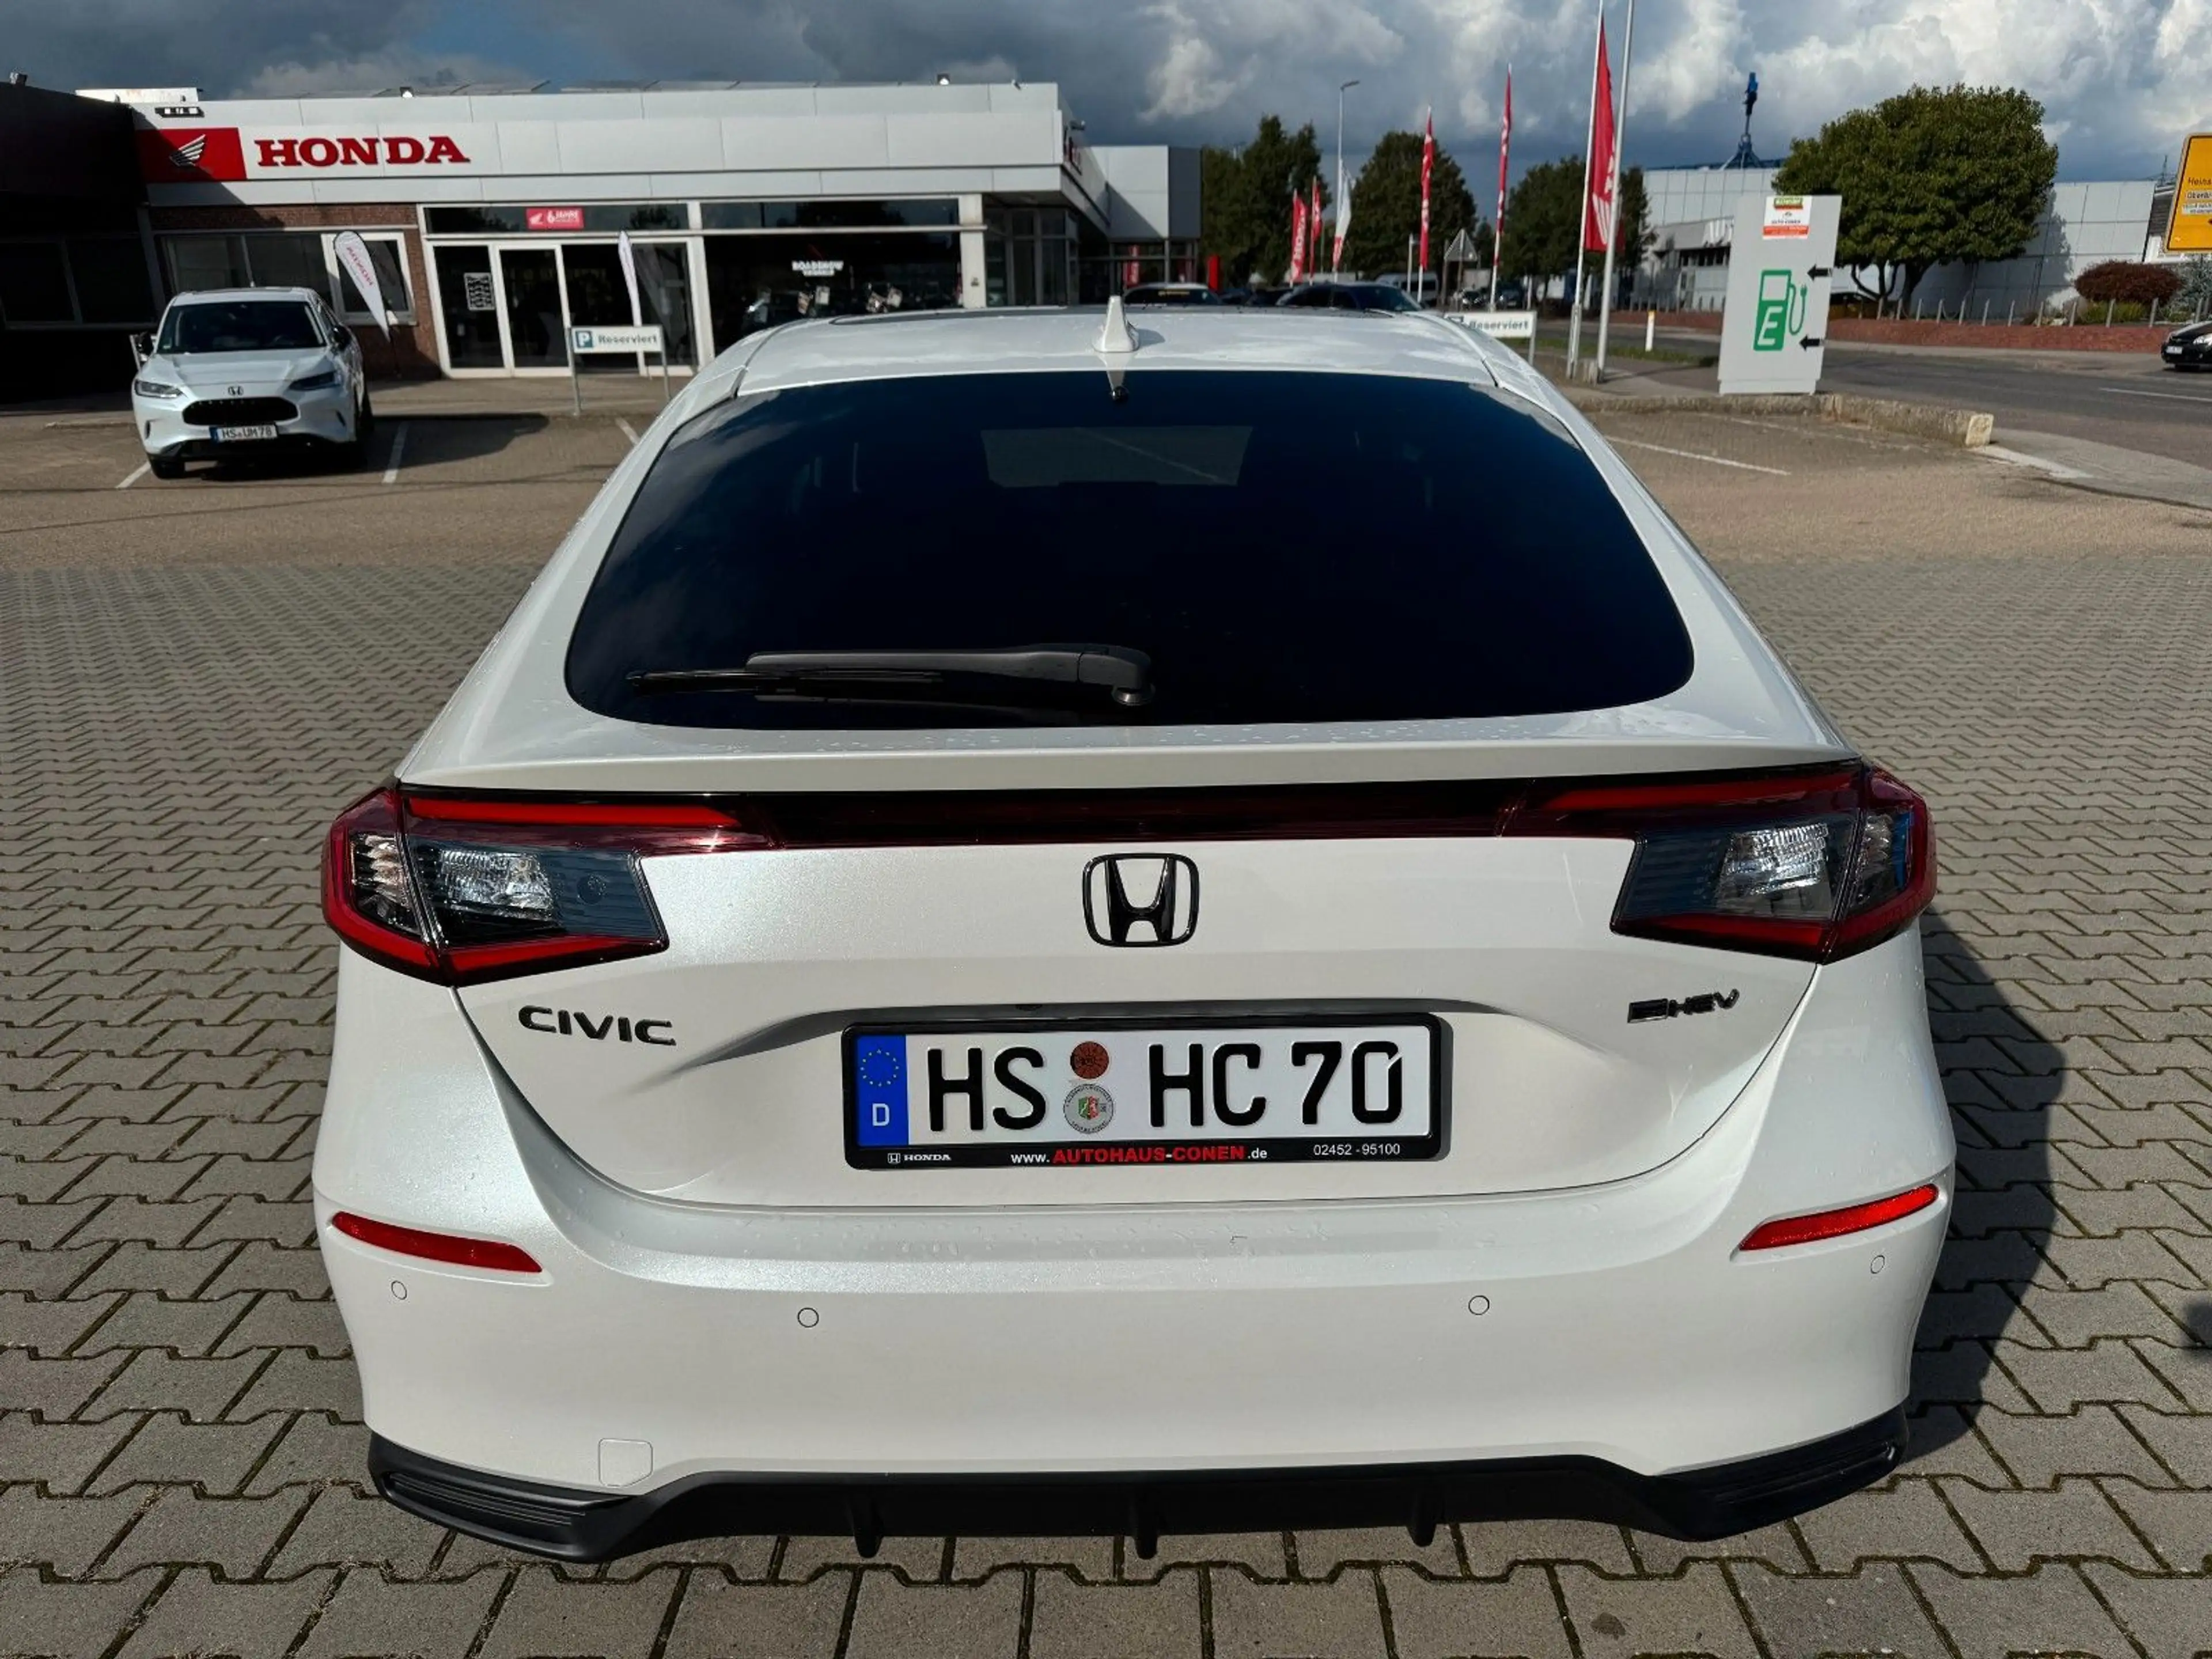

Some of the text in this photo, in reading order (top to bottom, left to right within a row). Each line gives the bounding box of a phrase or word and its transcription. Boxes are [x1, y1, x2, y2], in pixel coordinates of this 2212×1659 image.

[253, 136, 471, 167] HONDA
[578, 332, 657, 346] P Reserviert
[1758, 306, 1783, 346] E
[518, 1005, 676, 1046] CIVIC
[927, 1041, 1403, 1132] HS HC 70
[872, 1103, 890, 1127] D
